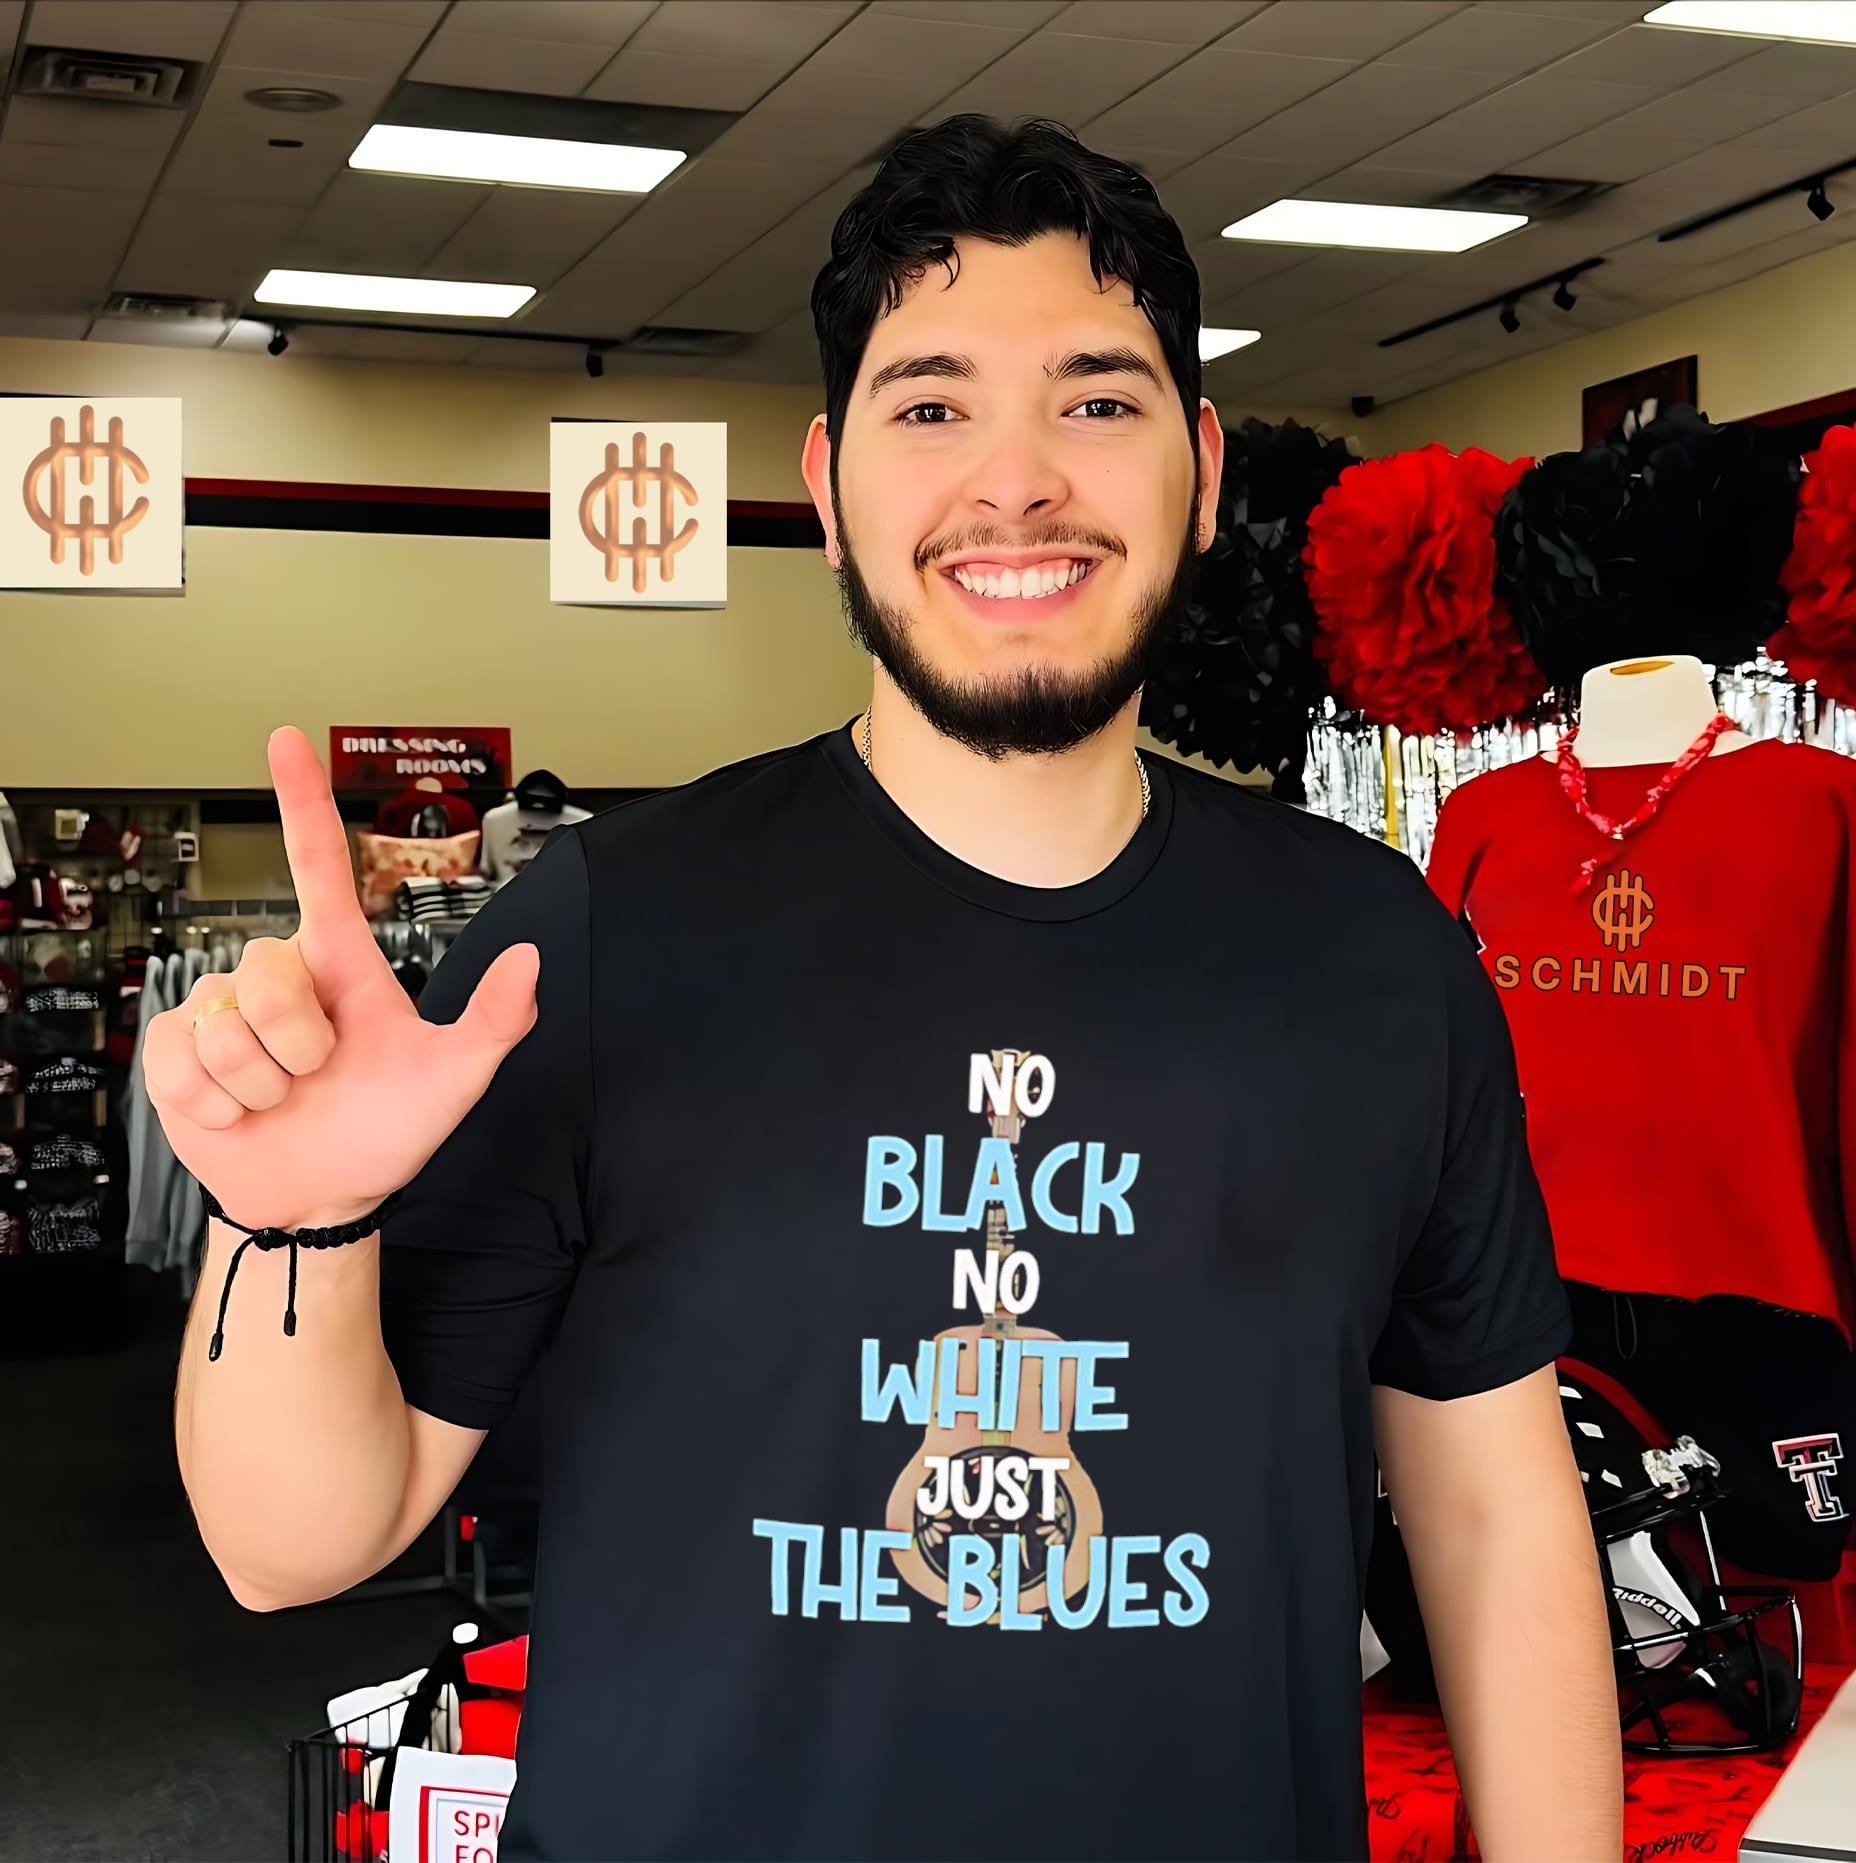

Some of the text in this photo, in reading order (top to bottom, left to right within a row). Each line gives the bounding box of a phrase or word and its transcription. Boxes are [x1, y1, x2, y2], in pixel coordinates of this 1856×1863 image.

[342, 737, 467, 754] DRESSING
[396, 758, 487, 775] ROOMS
[1494, 954, 1746, 1000] SCHMIDT
[968, 1053, 1056, 1118] NO
[863, 1135, 1140, 1235] BLACK
[953, 1249, 1040, 1316] NO
[861, 1338, 1129, 1432] WHITE
[916, 1456, 1070, 1521] JUST
[753, 1518, 1210, 1631] THE BLUES
